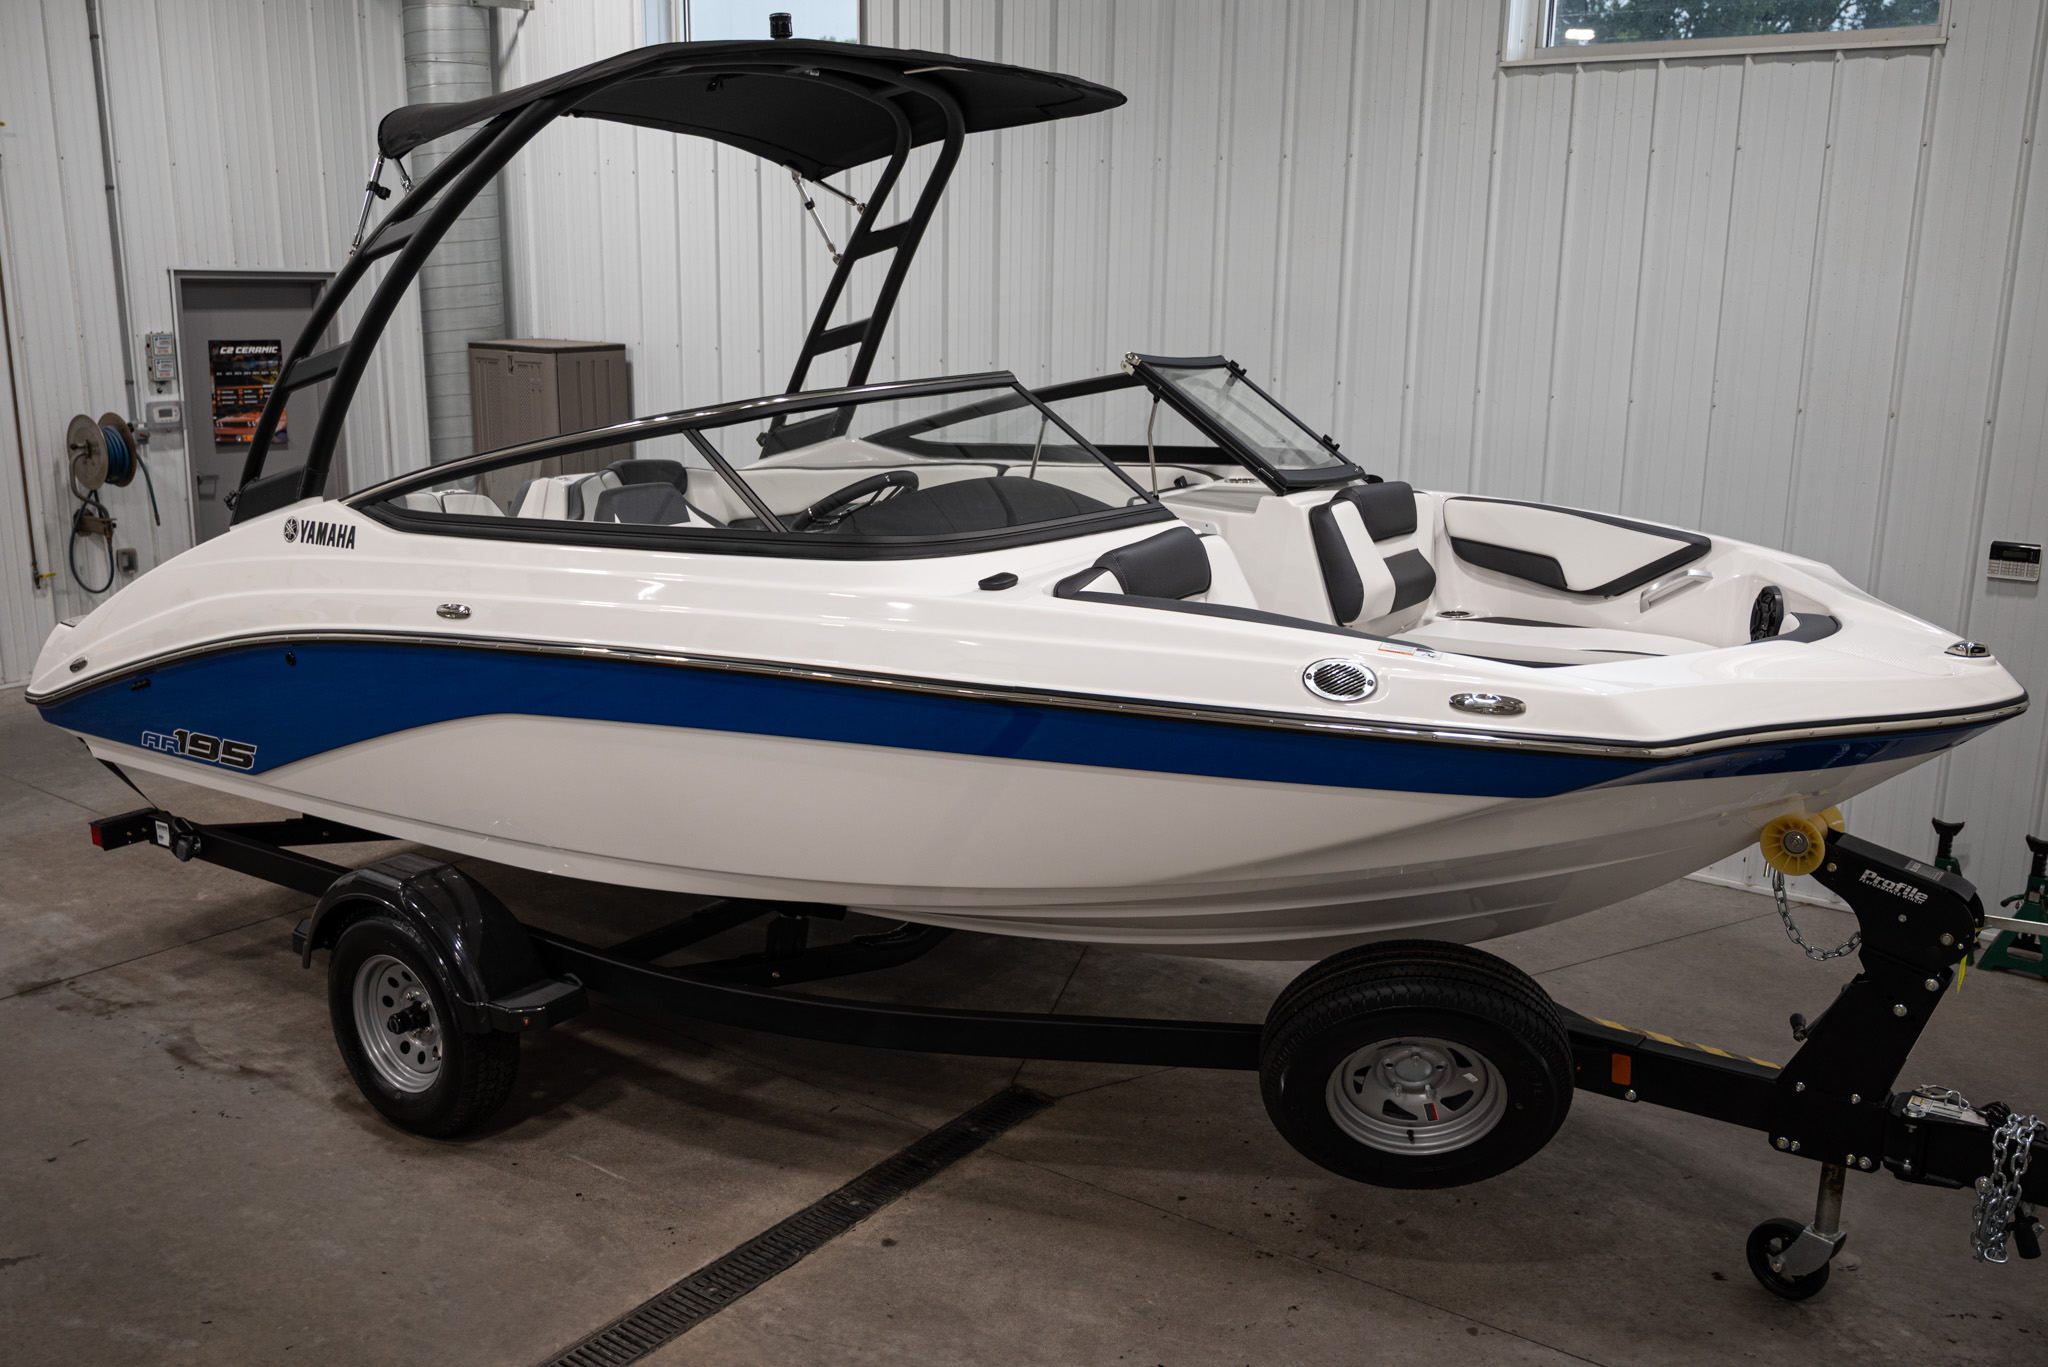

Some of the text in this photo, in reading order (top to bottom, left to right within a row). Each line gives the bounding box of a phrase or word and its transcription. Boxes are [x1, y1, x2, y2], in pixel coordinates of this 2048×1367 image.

[220, 346, 279, 354] C2 CERAMIC
[300, 519, 356, 550] YAMAHA
[1859, 878, 1923, 905] PERFORMANCE WINCH
[1860, 869, 1929, 902] Profile
